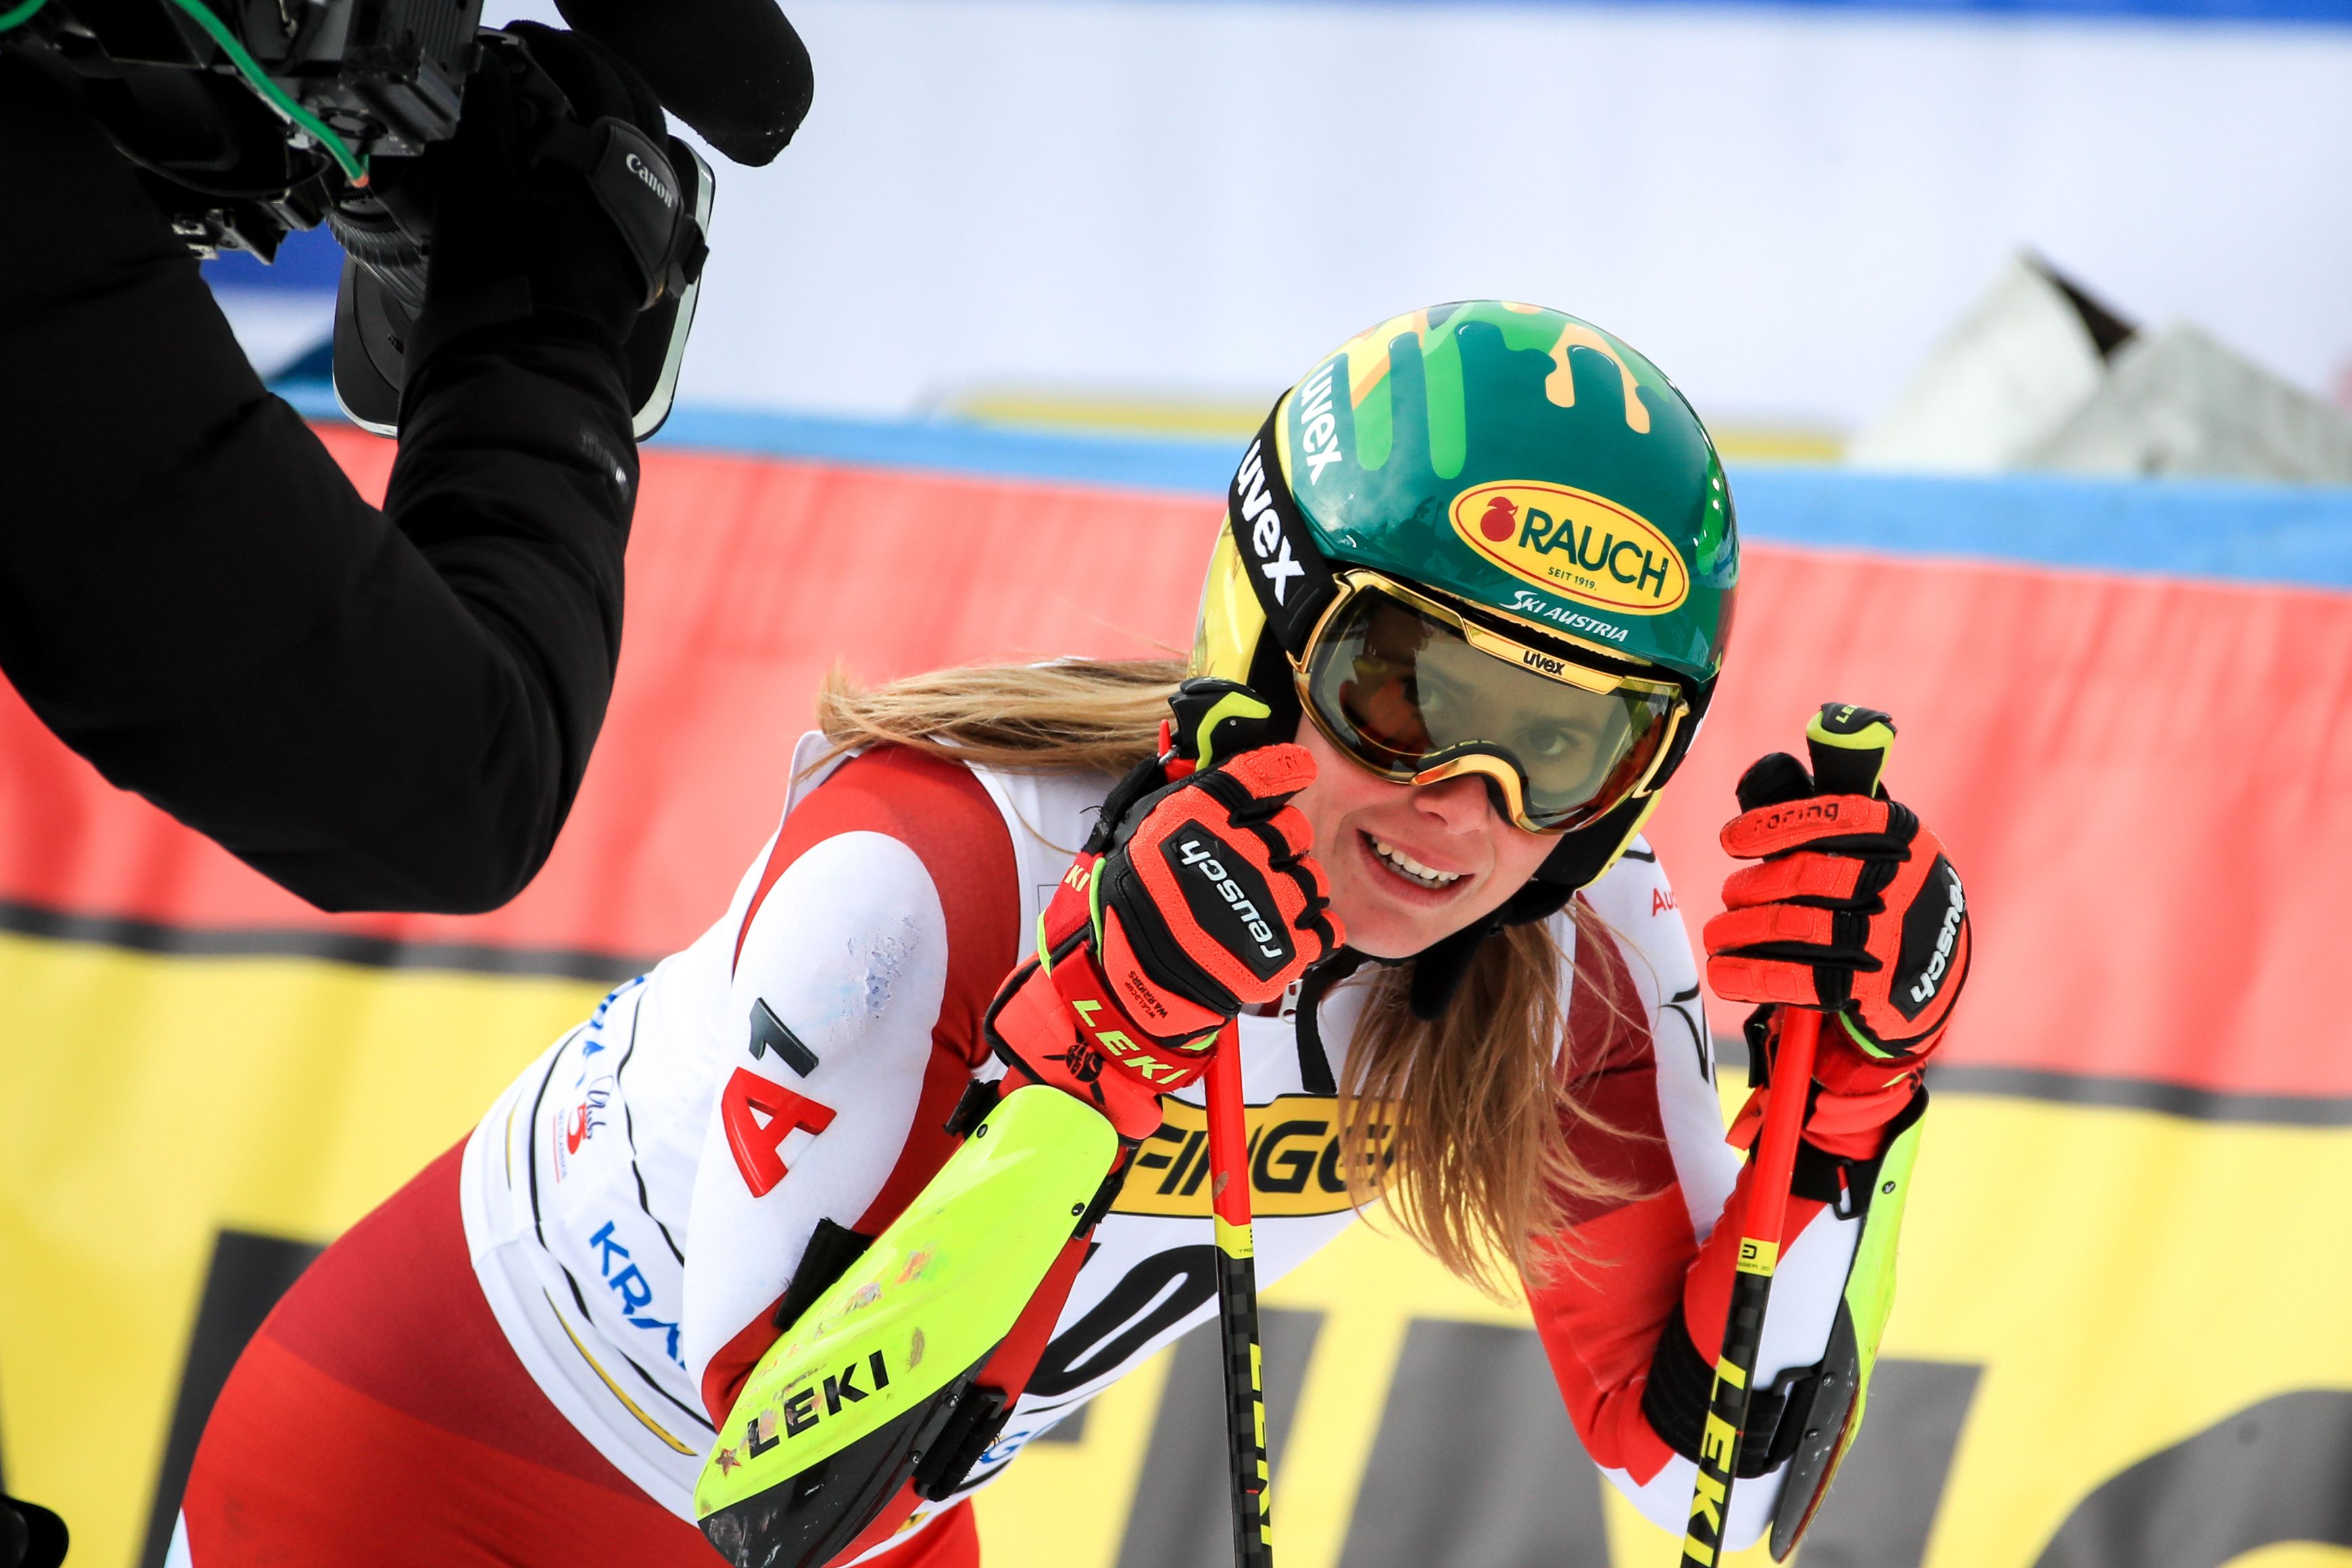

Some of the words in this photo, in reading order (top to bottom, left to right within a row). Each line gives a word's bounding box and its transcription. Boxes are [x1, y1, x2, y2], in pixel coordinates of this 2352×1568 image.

[626, 153, 672, 207] Canon
[1300, 364, 1343, 486] uvex
[1236, 439, 1305, 606] uvex
[1519, 507, 1669, 599] RAUCH
[1498, 590, 1547, 613] SKI
[1543, 607, 1629, 643] AUSTRIA
[1548, 566, 1572, 581] SEIT
[1523, 650, 1566, 676] uvex
[1835, 704, 1861, 724] LE
[1179, 839, 1283, 960] reusch
[1910, 866, 1963, 1003] reusch
[1071, 999, 1192, 1085] LEKI
[721, 997, 838, 1198] A1
[747, 1349, 890, 1459] LEKI
[1683, 1354, 1747, 1568] LEKI
